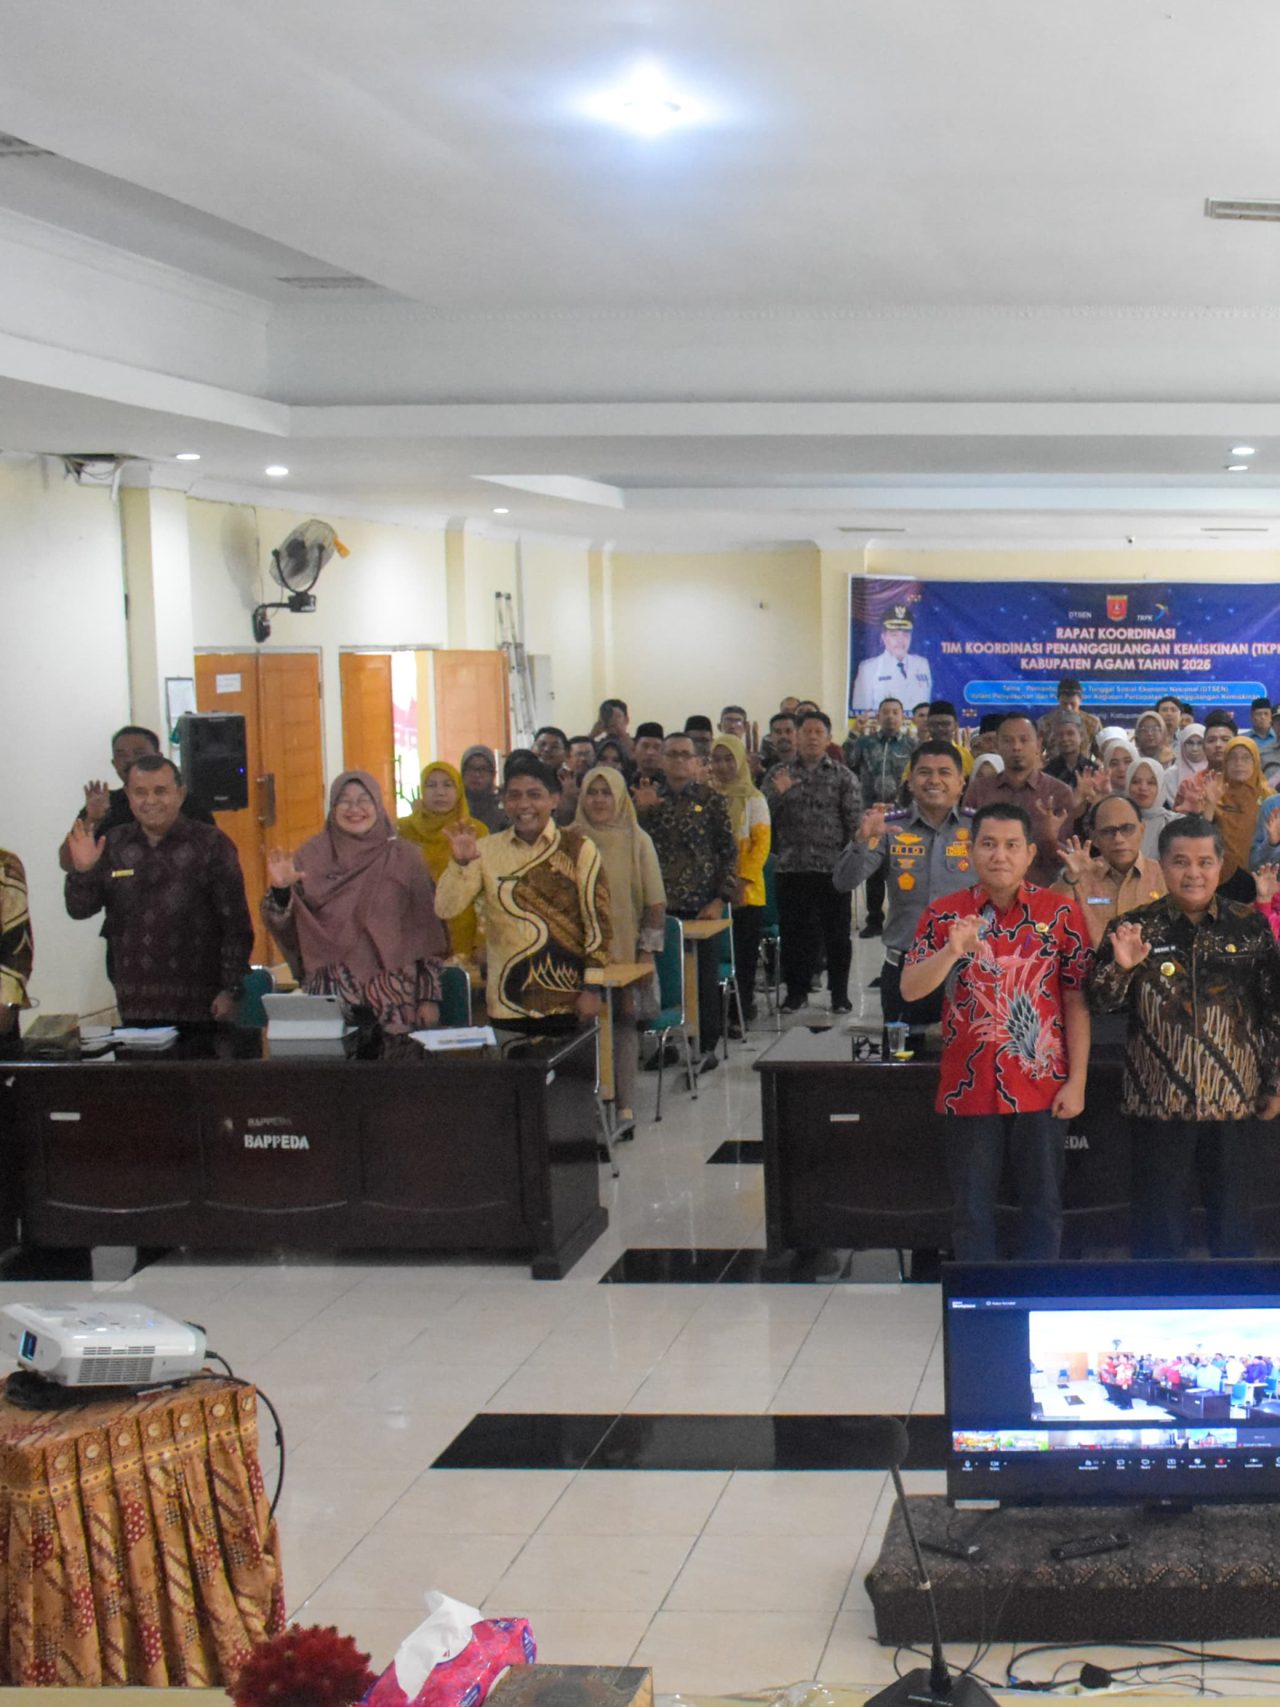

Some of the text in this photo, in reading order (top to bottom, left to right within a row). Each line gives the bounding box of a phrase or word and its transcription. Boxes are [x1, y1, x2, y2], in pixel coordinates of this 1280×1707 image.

[1055, 627, 1176, 640] RAPAT KOORDINASI
[941, 641, 963, 654] TIM
[965, 641, 1043, 655] KOORDINASI
[1046, 642, 1170, 656] PENANGGULANGAN
[1173, 643, 1249, 656] KEMISKINAN
[1020, 657, 1092, 670] KABUPATEN
[1094, 658, 1135, 671] AGAM
[1137, 658, 1180, 671] TAHUN
[244, 1134, 310, 1150] BAPPEDA
